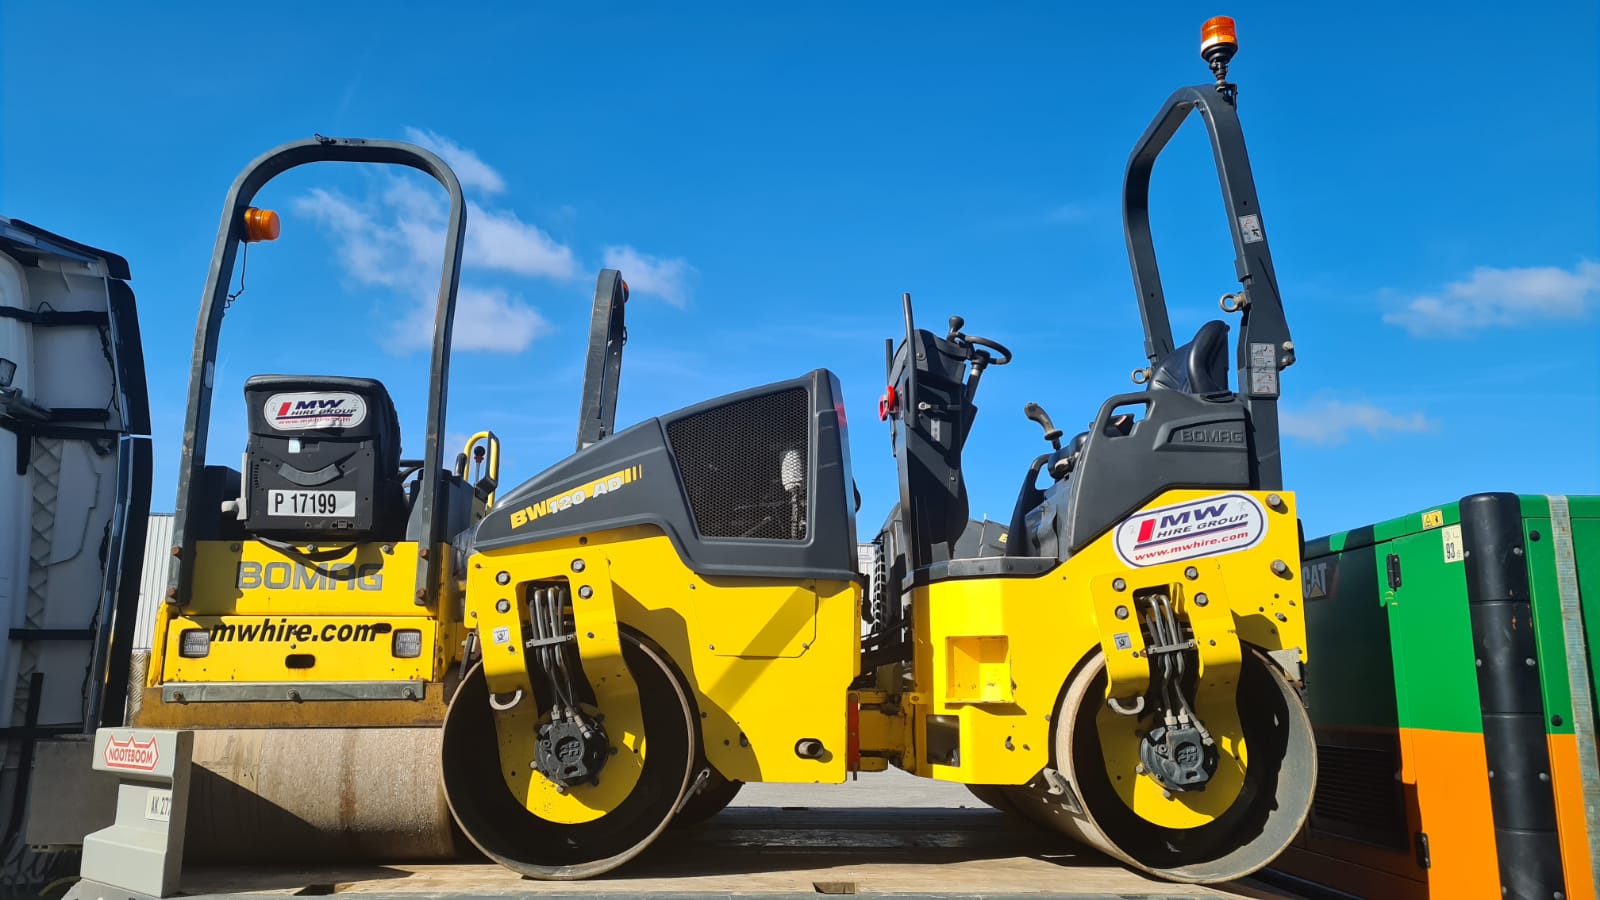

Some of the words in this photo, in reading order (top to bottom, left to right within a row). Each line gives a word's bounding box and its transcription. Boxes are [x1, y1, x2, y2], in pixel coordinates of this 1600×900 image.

[295, 399, 345, 410] MW
[319, 407, 357, 415] GROUP
[1181, 429, 1244, 443] BOMAG
[592, 477, 622, 499] AD
[274, 493, 284, 513] P
[290, 493, 336, 514] 17199
[1157, 525, 1192, 538] HIRE
[1197, 513, 1249, 530] GROUP
[1160, 503, 1228, 529] MW
[1134, 531, 1249, 561] www.mwhire.com
[235, 561, 383, 591] BOMAG
[1302, 562, 1327, 599] CAT
[209, 618, 377, 642] mwhire.com
[108, 747, 153, 764] NOOTEBOOM
